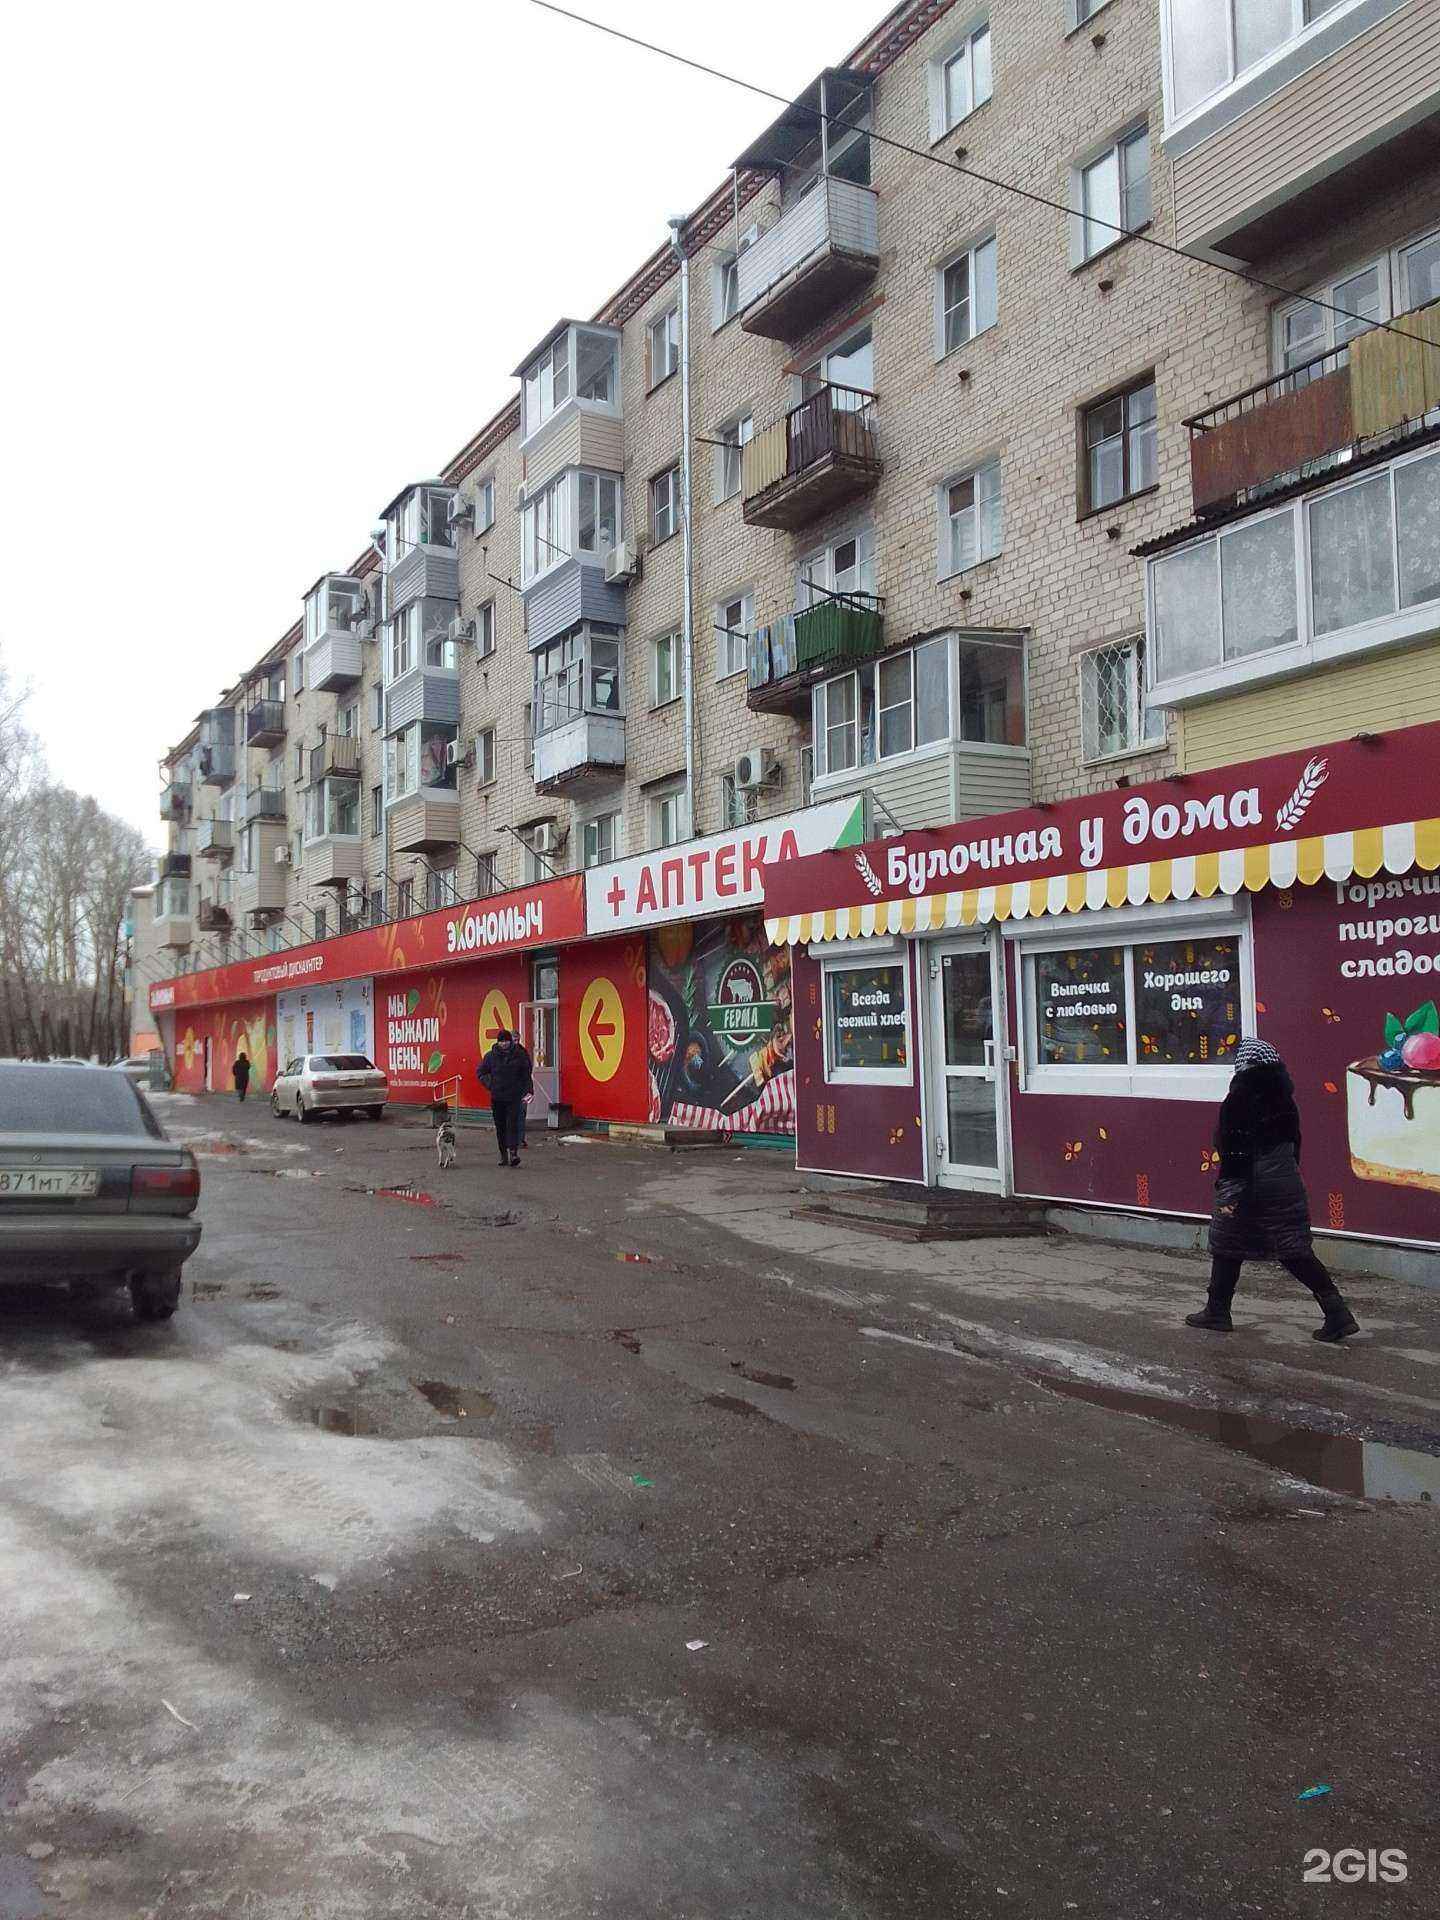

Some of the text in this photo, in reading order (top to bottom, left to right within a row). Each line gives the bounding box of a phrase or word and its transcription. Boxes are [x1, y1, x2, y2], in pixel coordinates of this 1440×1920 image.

[887, 785, 1263, 896] Булочная у дома
[635, 828, 800, 914] АПТЕКА
[447, 899, 543, 952] ЭКОНОМЫЧ
[1050, 981, 1110, 997] Выпечка
[1143, 968, 1230, 991] Хорошего
[388, 993, 407, 1018] МЫ
[851, 989, 890, 1007] Всегда
[1045, 1001, 1117, 1018] с любовью
[1170, 993, 1203, 1011] дня
[388, 1017, 440, 1044] ВЫЖАЛИ
[837, 1009, 908, 1028] свежий хлеб
[389, 1045, 424, 1075] ЦЕНЫ,
